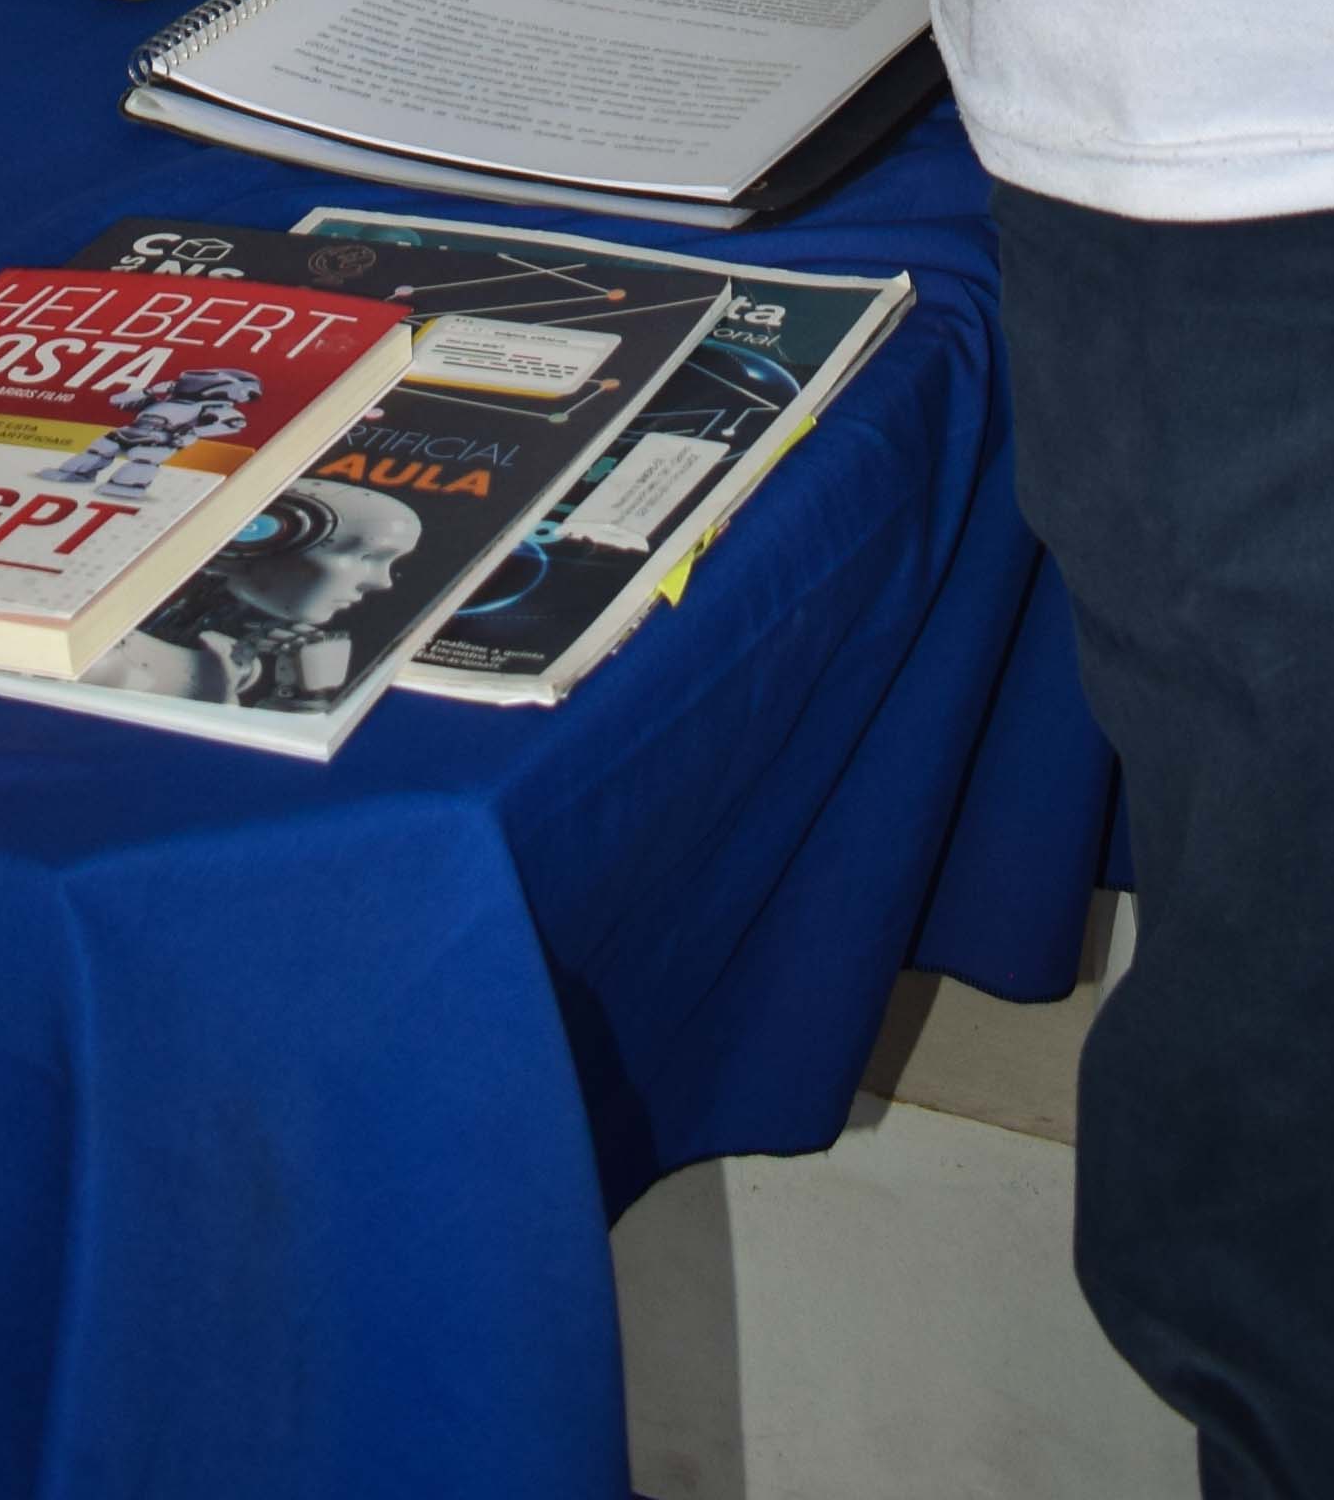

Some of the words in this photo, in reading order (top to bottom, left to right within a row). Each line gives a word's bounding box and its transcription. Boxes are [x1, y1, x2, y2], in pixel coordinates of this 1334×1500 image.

[725, 295, 787, 328] ta
[712, 326, 781, 348] onal
[345, 426, 521, 467] RTIFICIAL
[316, 452, 491, 499] AULA
